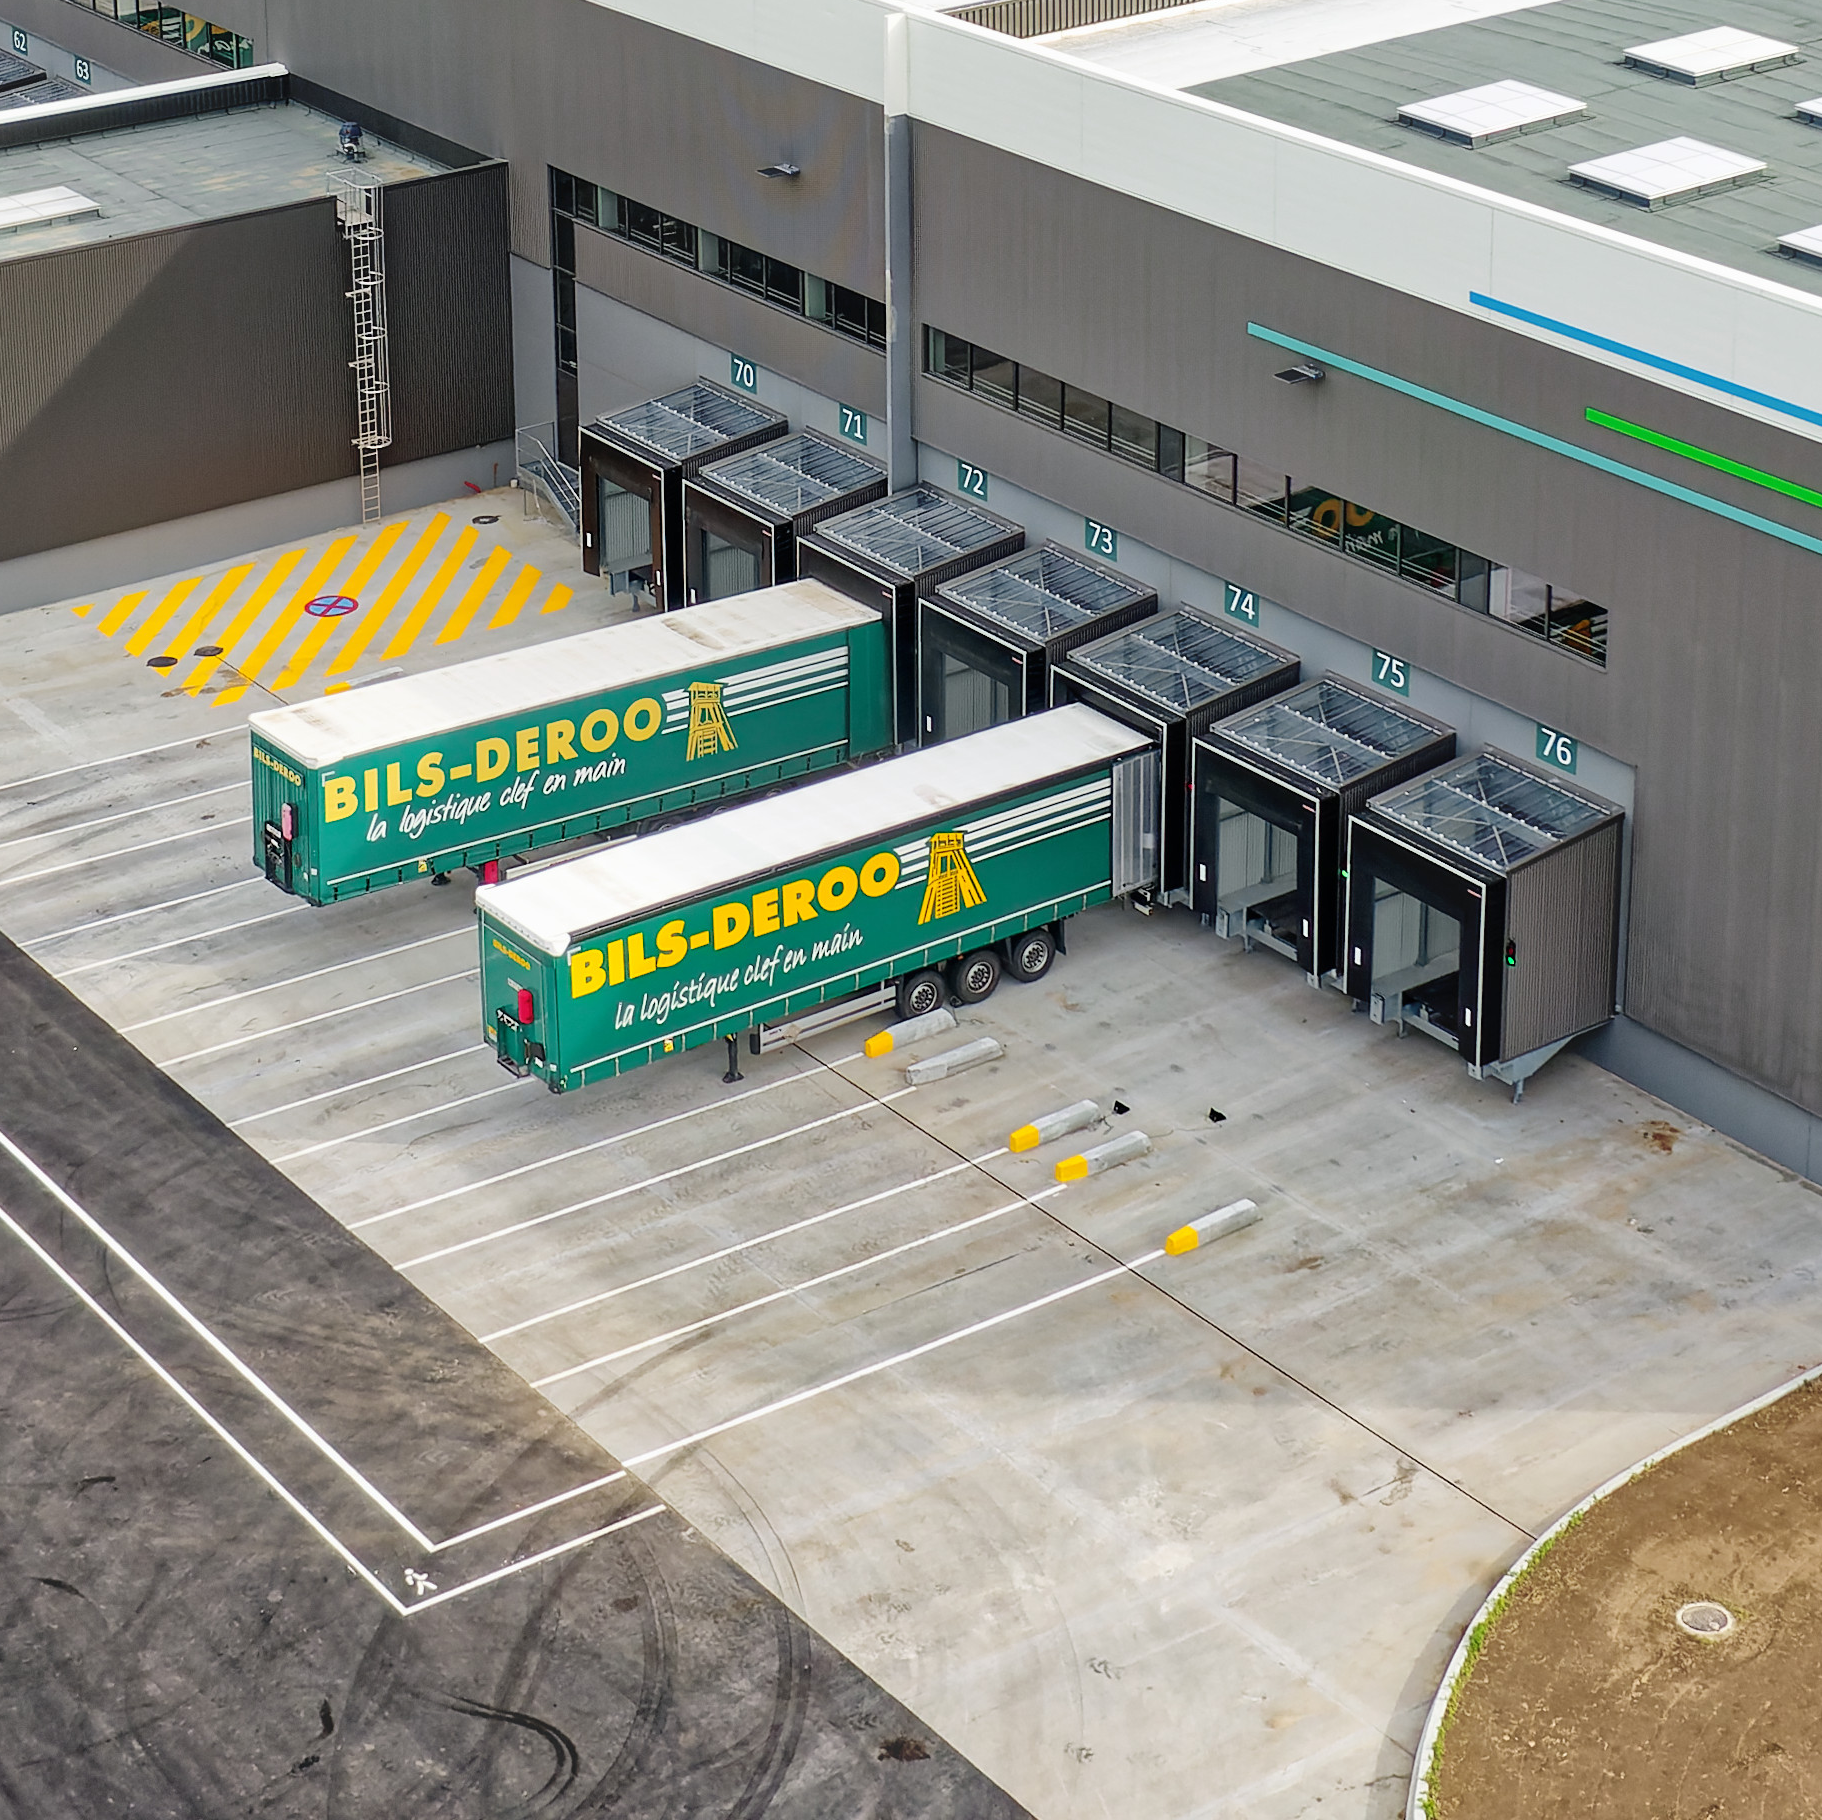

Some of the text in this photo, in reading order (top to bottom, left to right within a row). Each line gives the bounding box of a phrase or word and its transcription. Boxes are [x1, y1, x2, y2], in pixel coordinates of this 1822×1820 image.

[14, 30, 27, 51] 62
[75, 59, 89, 80] 63
[733, 358, 754, 387] 70
[842, 408, 864, 440] 71
[961, 463, 984, 496] 72
[1089, 521, 1113, 554] 73
[1227, 584, 1256, 620] 74
[1377, 652, 1405, 688] 75
[324, 697, 662, 823] BILS-DEROO
[1540, 728, 1570, 765] 76
[253, 747, 301, 787] BILS-DEROO
[399, 791, 491, 840] logistique
[499, 769, 540, 810] clef
[542, 771, 566, 795] en
[573, 752, 626, 787] main
[570, 852, 900, 999] BILS-DEROO
[640, 967, 739, 1024] logistique
[743, 944, 783, 987] clef
[783, 948, 807, 973] en
[811, 922, 863, 962] main
